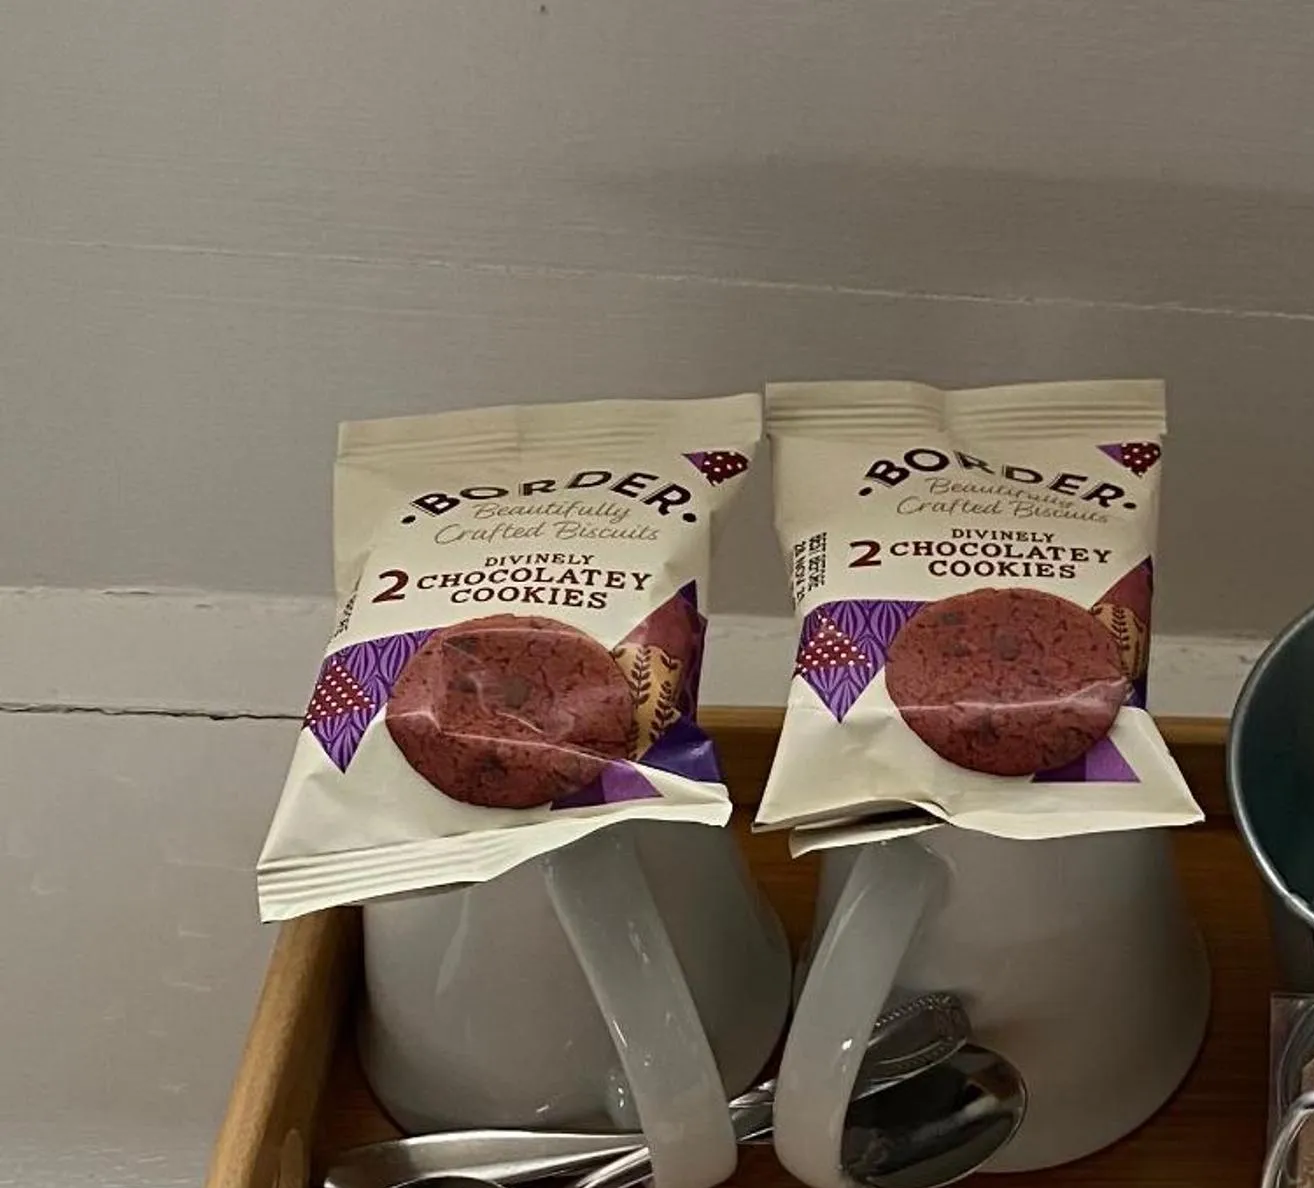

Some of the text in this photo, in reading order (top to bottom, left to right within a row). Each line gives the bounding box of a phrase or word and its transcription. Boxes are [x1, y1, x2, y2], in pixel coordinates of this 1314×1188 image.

[864, 448, 1125, 508] BORDER
[411, 470, 691, 517] BORDER
[472, 500, 632, 524] Beautifully
[897, 496, 1002, 516] Crafted
[434, 520, 660, 546] Crafted Biscuits
[951, 528, 1055, 543] DIVINELY
[484, 553, 595, 567] DIVINELY
[848, 540, 882, 569] 2
[889, 541, 1113, 564] CHOCOLATEY
[928, 560, 1076, 580] COOKIES
[371, 567, 652, 604] 2 CHOCOLATEY
[450, 586, 608, 610] COOKIES
